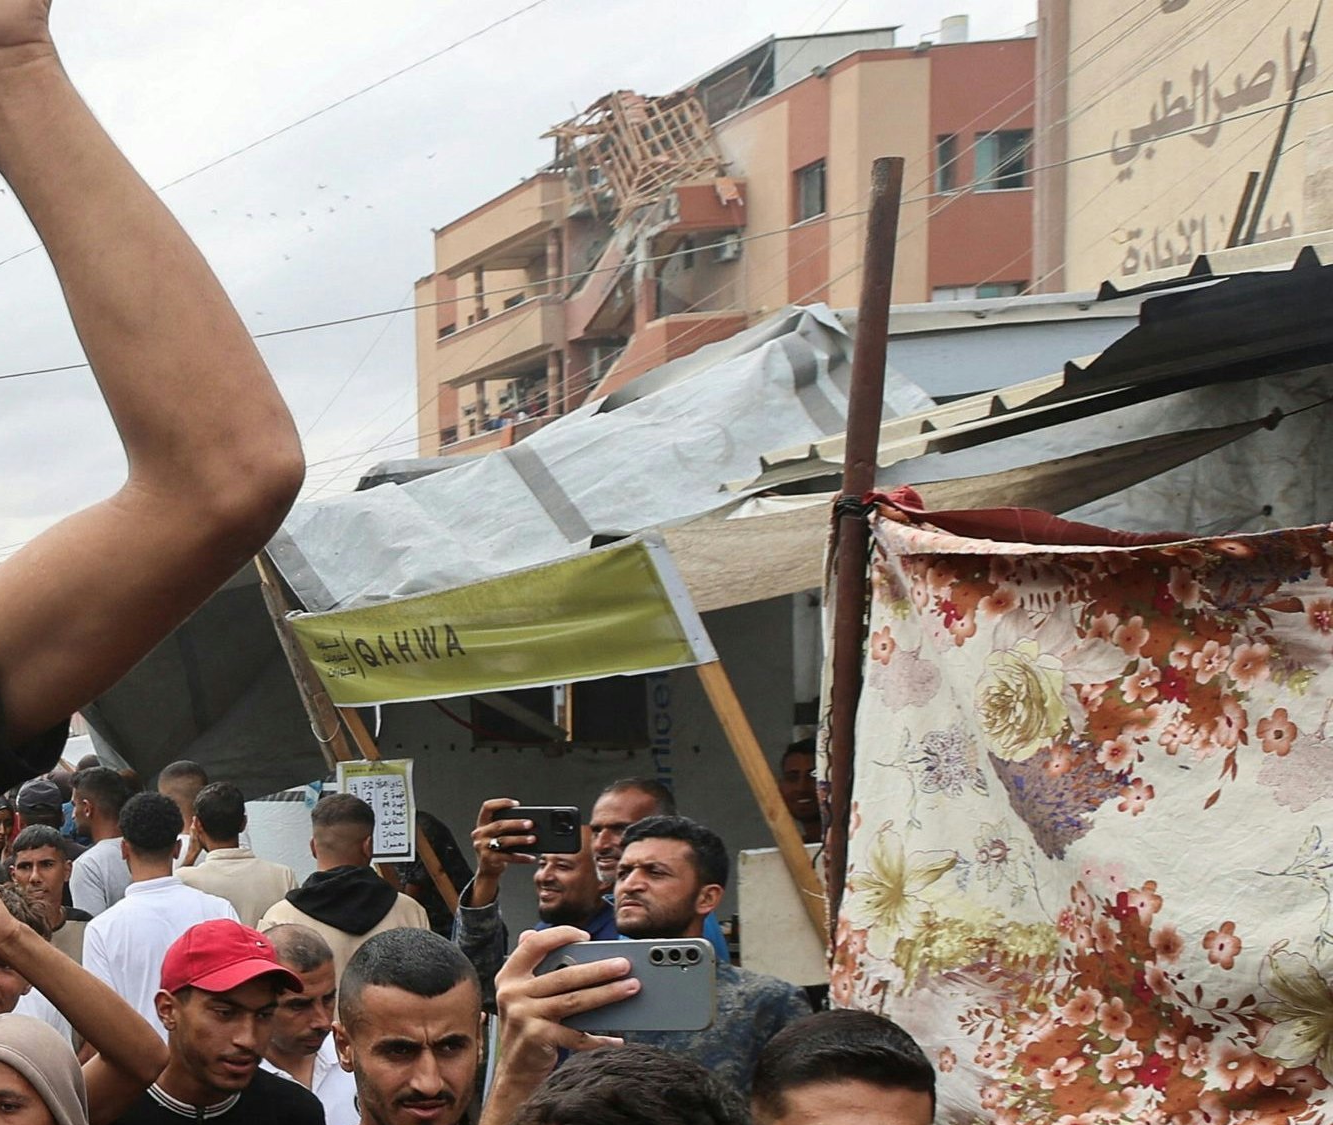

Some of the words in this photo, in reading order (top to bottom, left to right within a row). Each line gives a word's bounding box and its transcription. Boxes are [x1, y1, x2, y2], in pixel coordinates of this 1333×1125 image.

[1110, 60, 1211, 183] الطبي
[354, 623, 467, 669] QAHWA
[651, 672, 674, 790] nice
